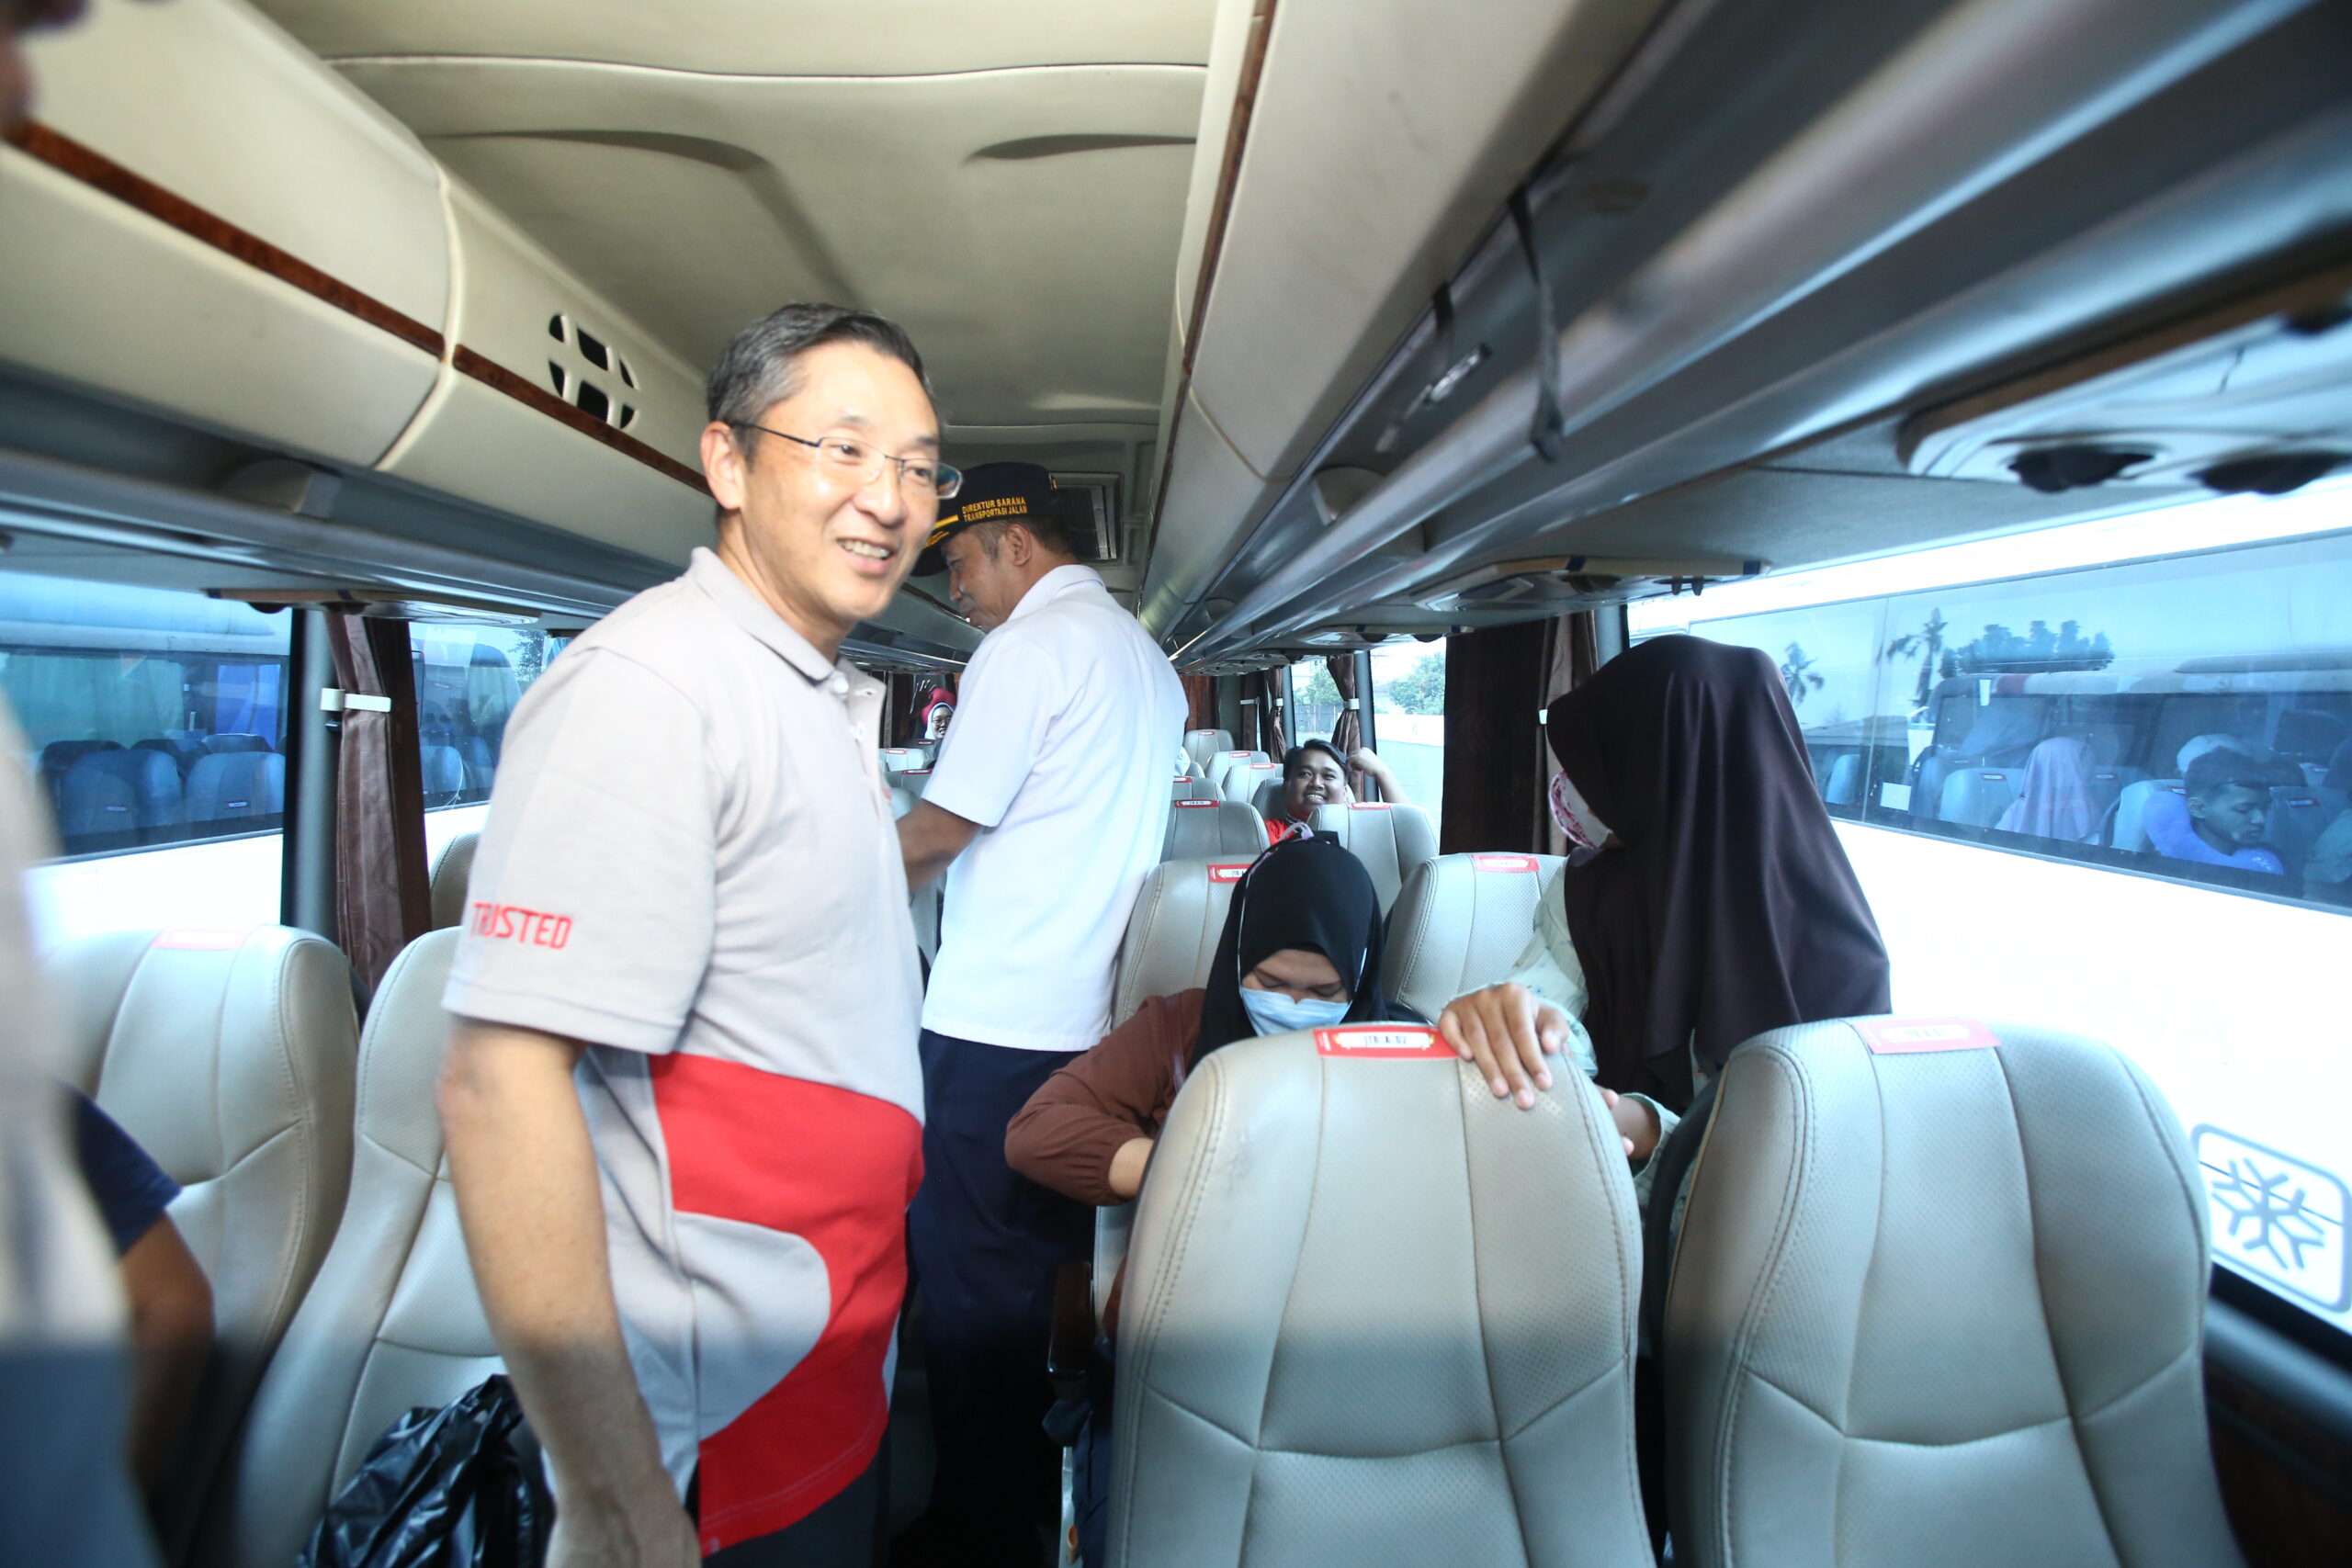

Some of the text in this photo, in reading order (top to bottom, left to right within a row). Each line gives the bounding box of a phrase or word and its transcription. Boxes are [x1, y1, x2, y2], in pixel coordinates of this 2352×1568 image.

[962, 497, 1026, 513] DIREKTUR SARANA
[963, 505, 1027, 522] TRANSPORTASI JALAN
[469, 901, 573, 950] TRUSTED
